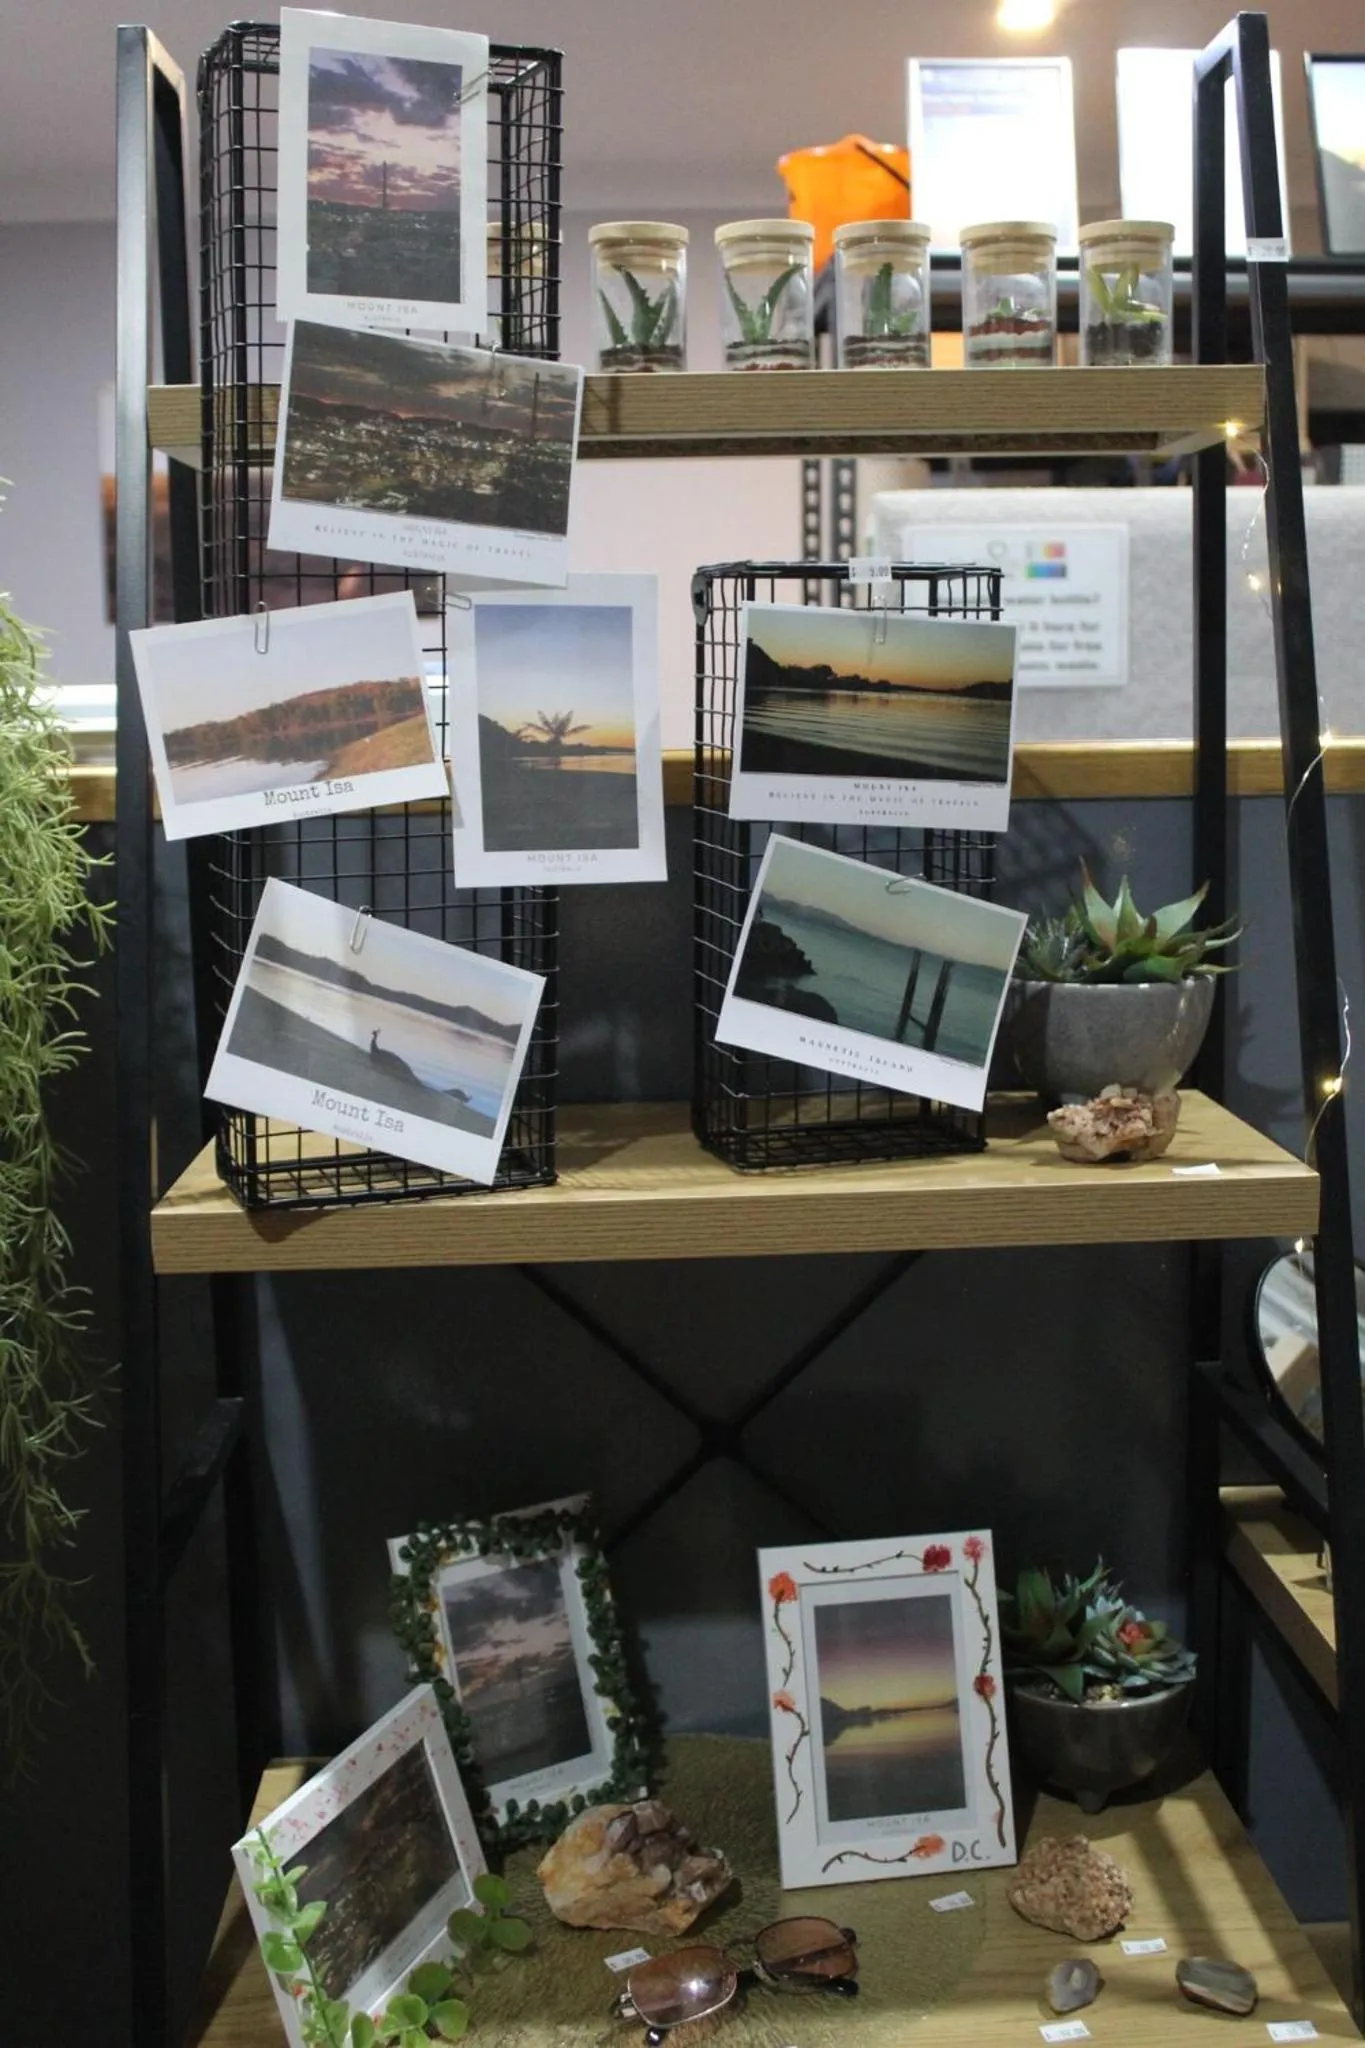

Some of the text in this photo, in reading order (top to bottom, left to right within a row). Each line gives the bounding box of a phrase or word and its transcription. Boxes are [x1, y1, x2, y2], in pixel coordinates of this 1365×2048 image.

[346, 302, 419, 315] MOUNT ISA
[263, 781, 354, 806] Mount Isa
[527, 852, 599, 863] MOUNT ISA
[311, 1089, 405, 1133] Mount Isa
[952, 1840, 991, 1863] D.C.
